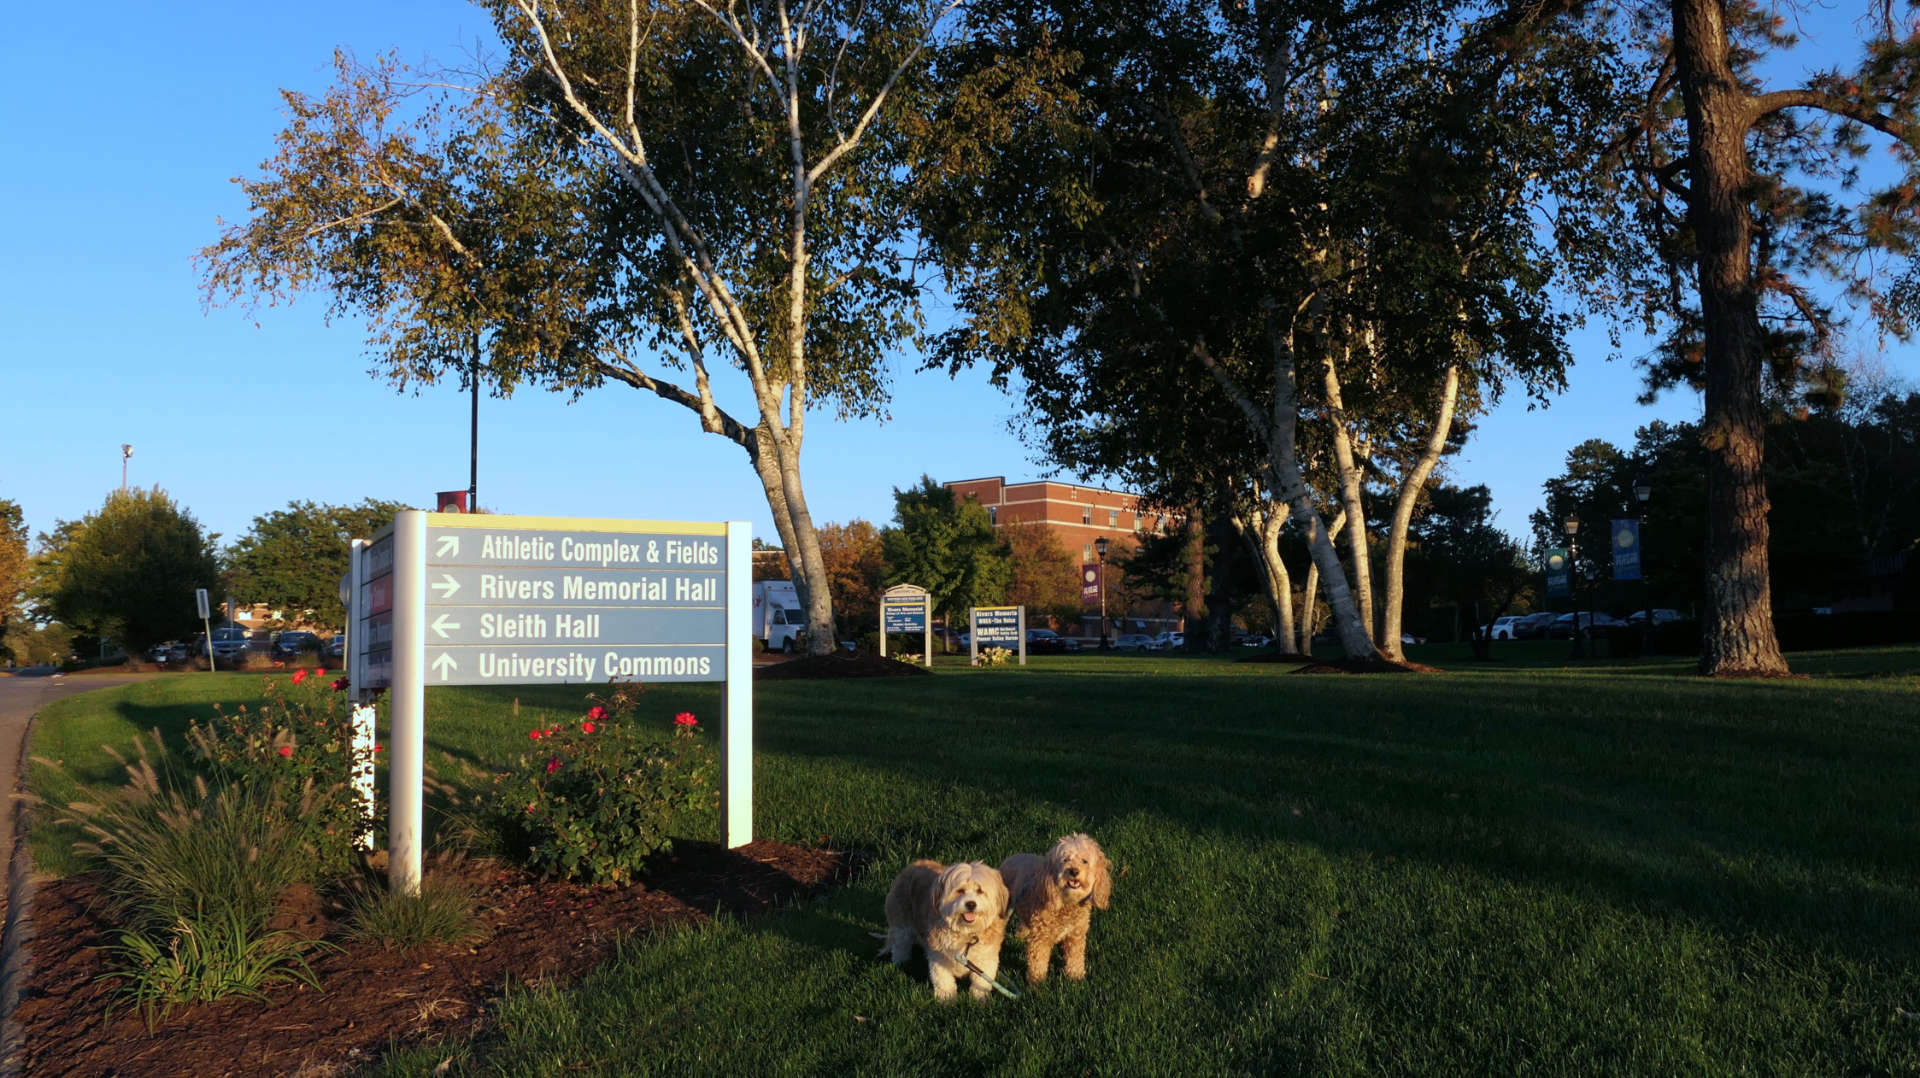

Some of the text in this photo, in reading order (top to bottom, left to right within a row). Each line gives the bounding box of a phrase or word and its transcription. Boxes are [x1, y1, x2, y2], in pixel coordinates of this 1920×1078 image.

[481, 535, 719, 567] Athletic Complex & Fields
[480, 575, 716, 601] Rivers Memorial Hall
[480, 613, 599, 638] Sleith Hall
[480, 652, 710, 681] University Commons
